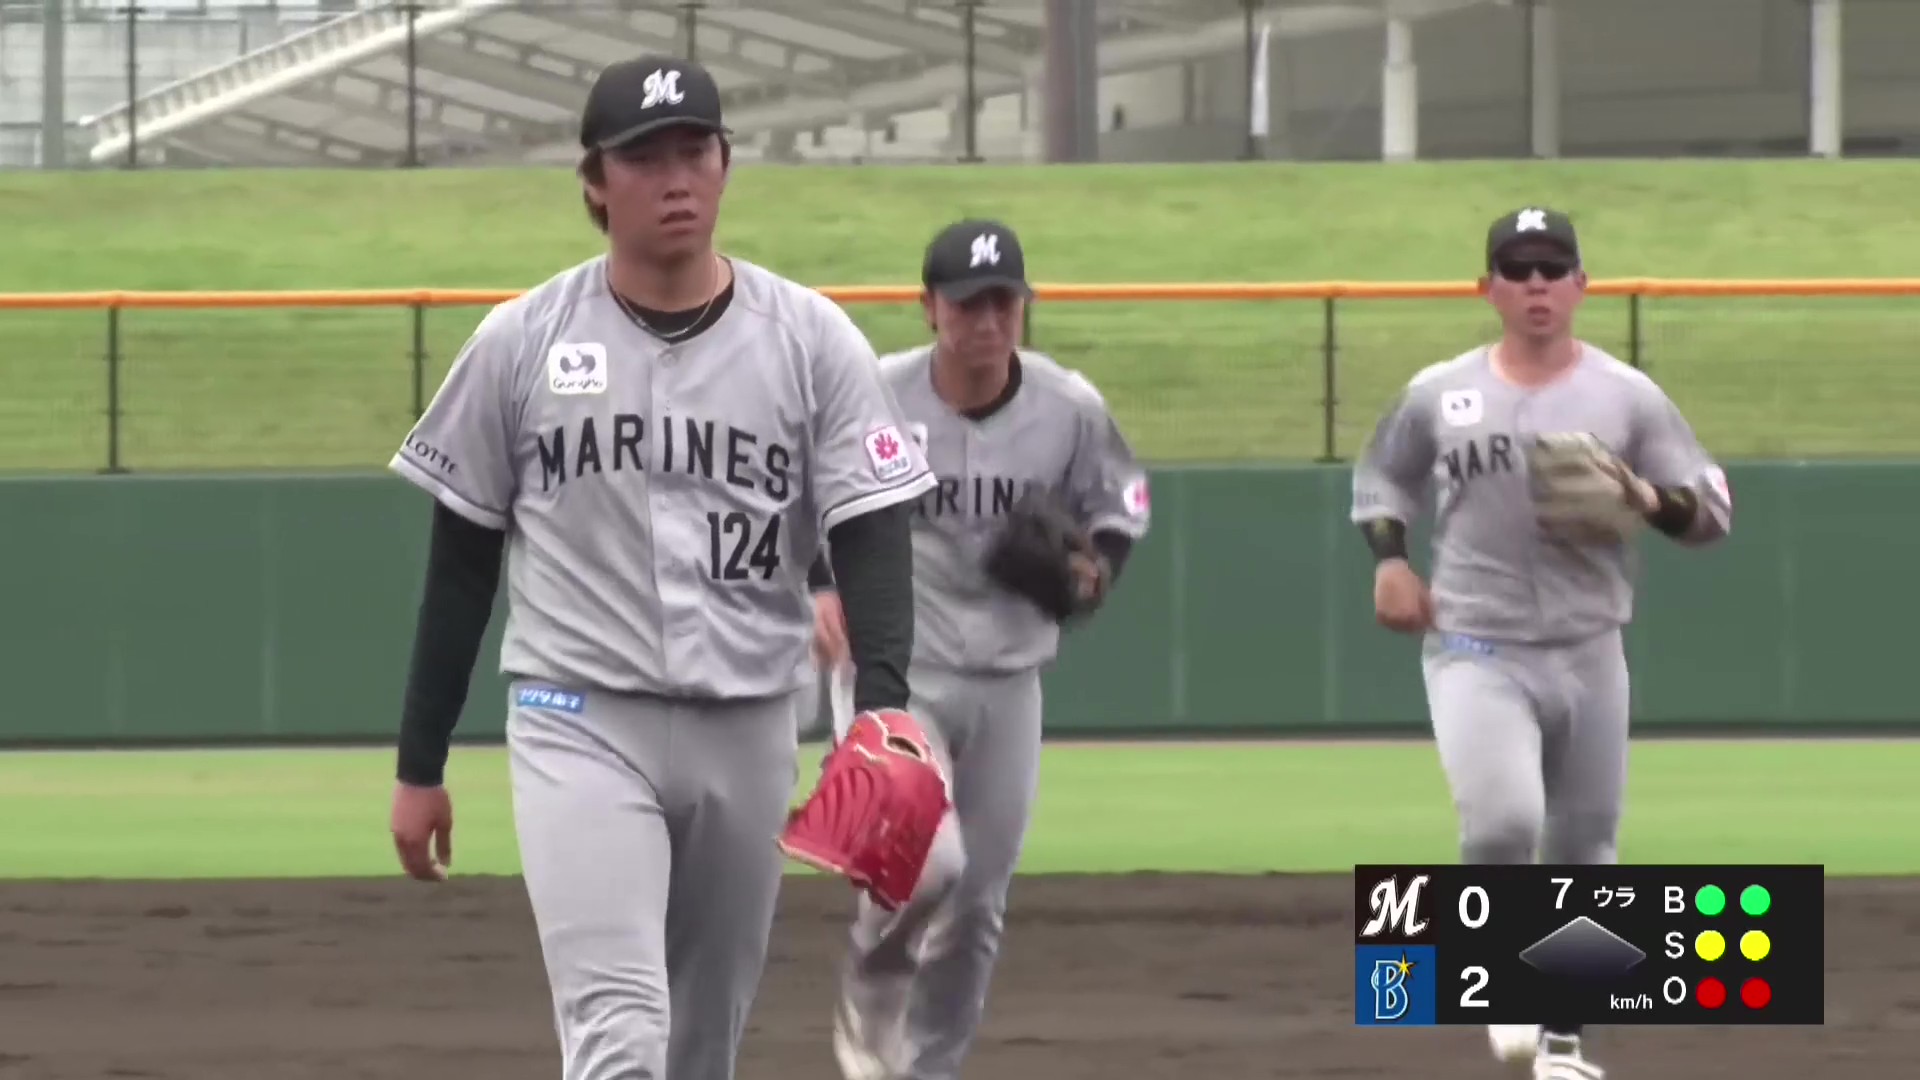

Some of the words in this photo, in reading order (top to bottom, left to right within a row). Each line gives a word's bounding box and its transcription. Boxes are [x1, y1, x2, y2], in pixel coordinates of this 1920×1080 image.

[640, 68, 685, 109] M
[969, 233, 1001, 268] M
[537, 413, 791, 502] MARINES
[708, 511, 780, 580] 124
